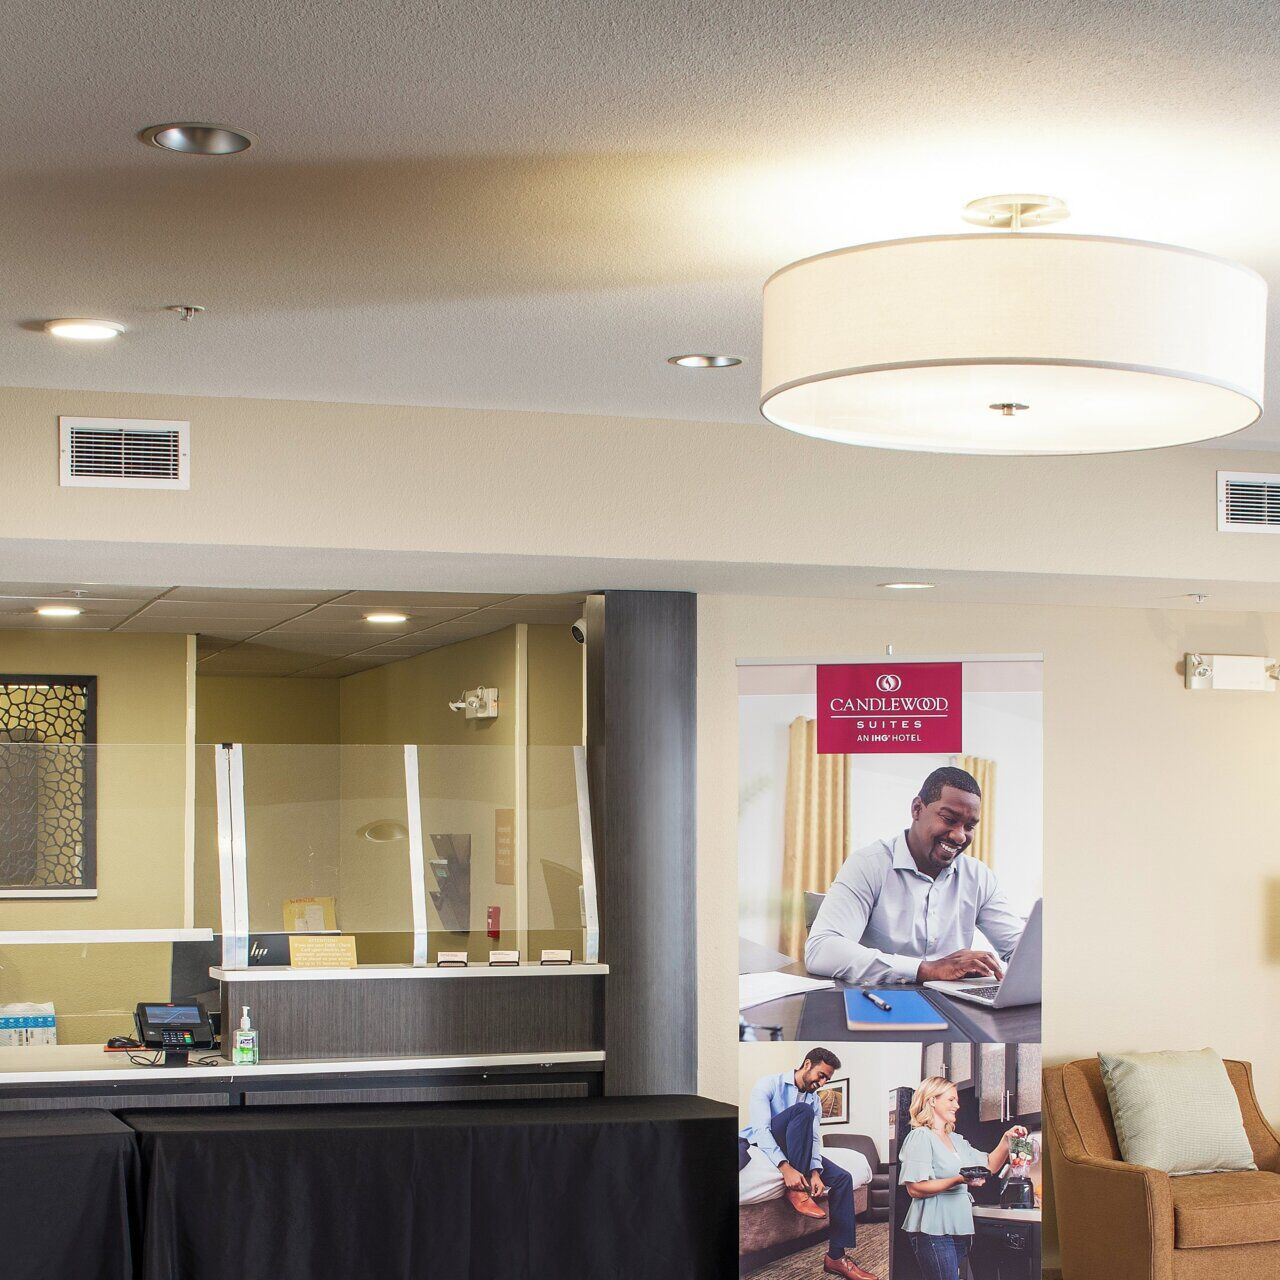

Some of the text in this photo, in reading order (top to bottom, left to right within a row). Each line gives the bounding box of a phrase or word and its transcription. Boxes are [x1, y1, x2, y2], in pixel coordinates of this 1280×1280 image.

[830, 697, 948, 712] CANDLEWOOD
[856, 720, 922, 729] SUITES
[857, 734, 869, 742] AN
[892, 734, 922, 742] HOTEL
